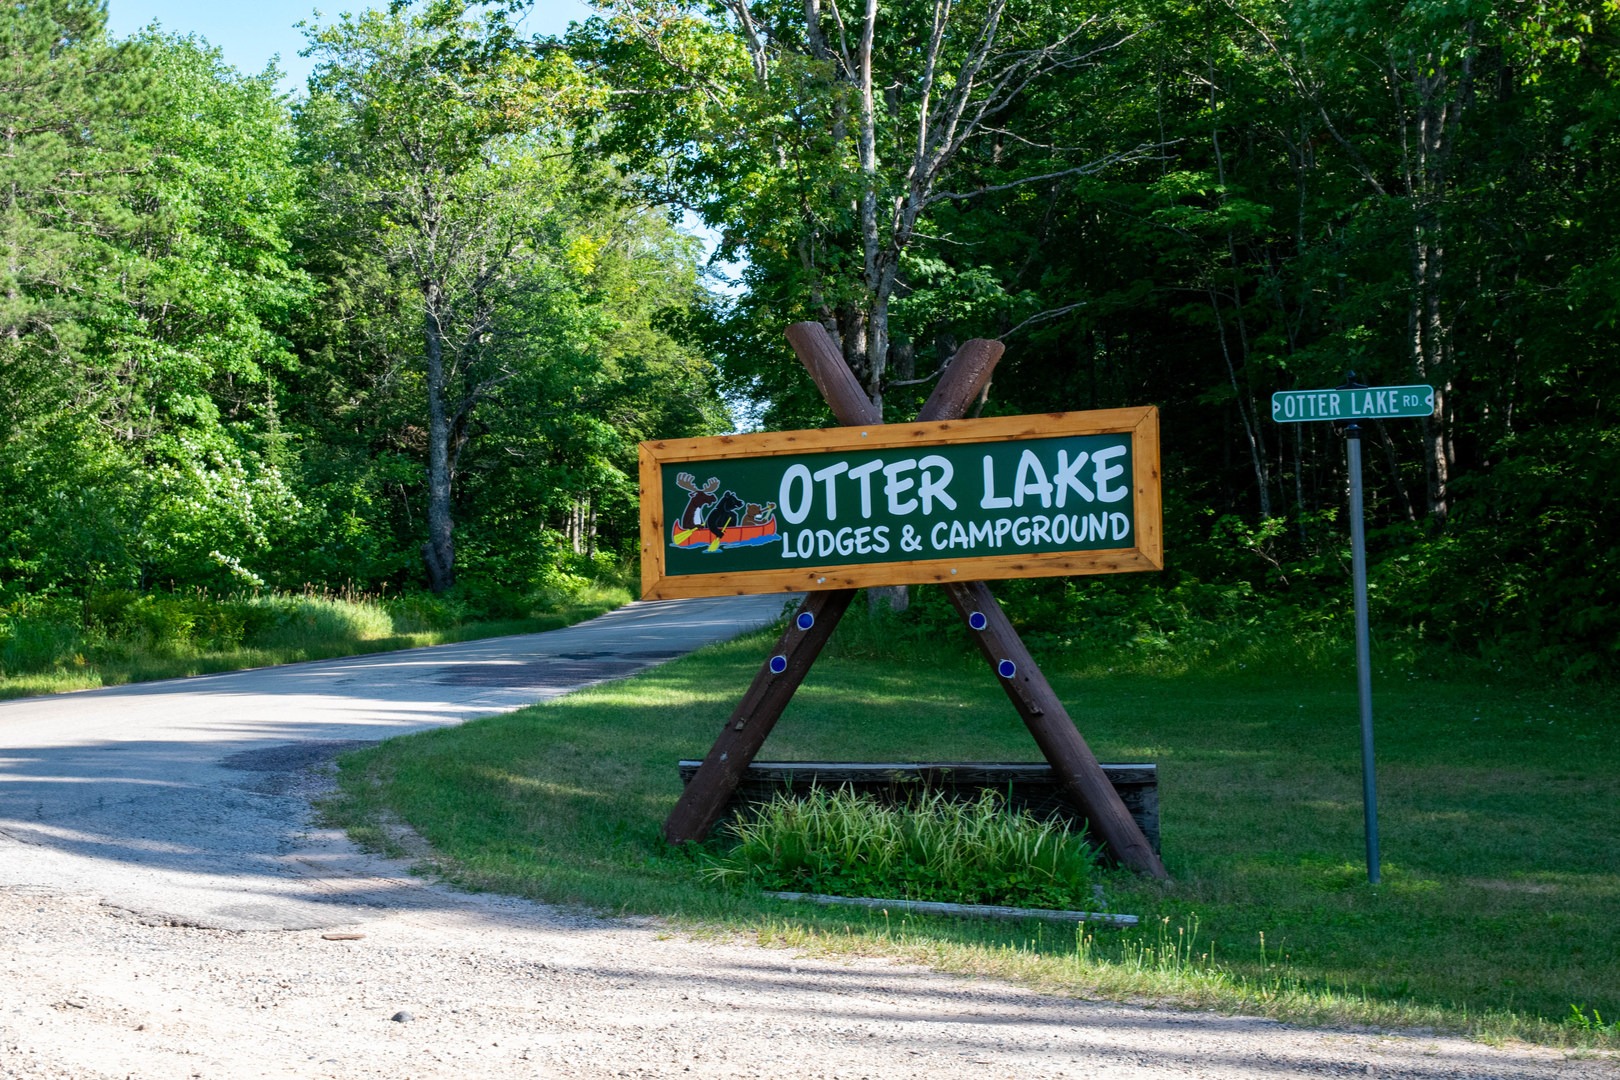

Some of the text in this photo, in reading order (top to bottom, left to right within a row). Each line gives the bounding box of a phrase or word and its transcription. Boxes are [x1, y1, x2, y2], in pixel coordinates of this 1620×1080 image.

[1284, 393, 1341, 418] OTTER
[1351, 390, 1400, 415] LAKE
[778, 445, 1128, 525] OTTER LAKE
[781, 511, 1130, 559] LODGES & CAMPGROUND
